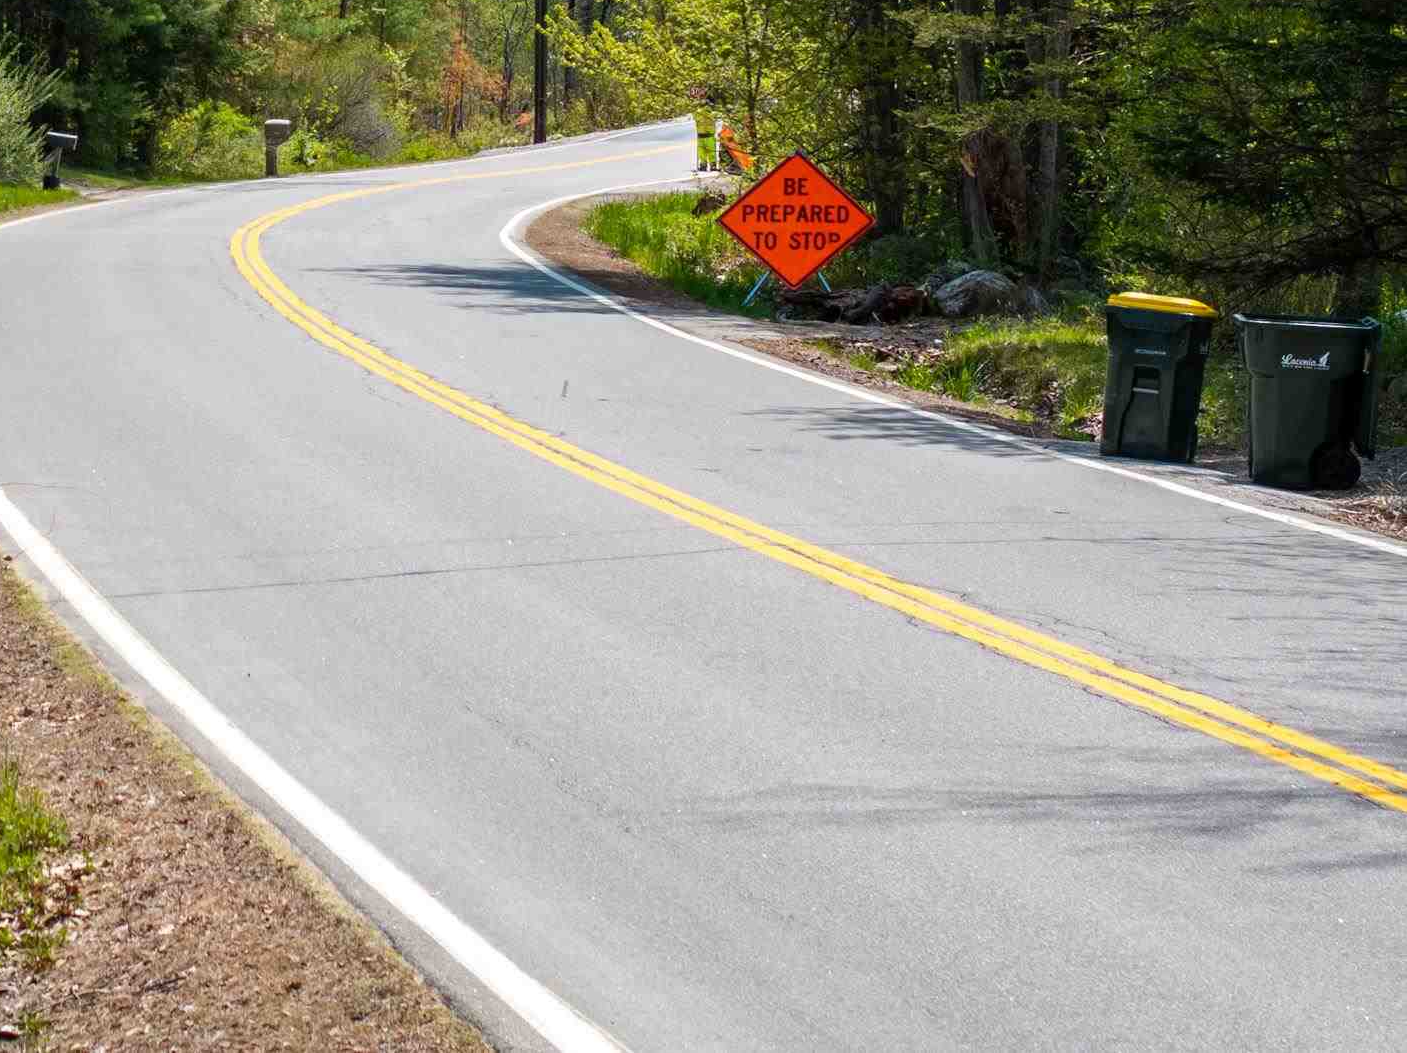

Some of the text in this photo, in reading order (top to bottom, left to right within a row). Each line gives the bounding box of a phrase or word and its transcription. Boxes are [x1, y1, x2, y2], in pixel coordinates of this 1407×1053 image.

[783, 177, 809, 196] BE
[741, 204, 850, 224] PREPARED
[753, 231, 841, 250] TO STOP
